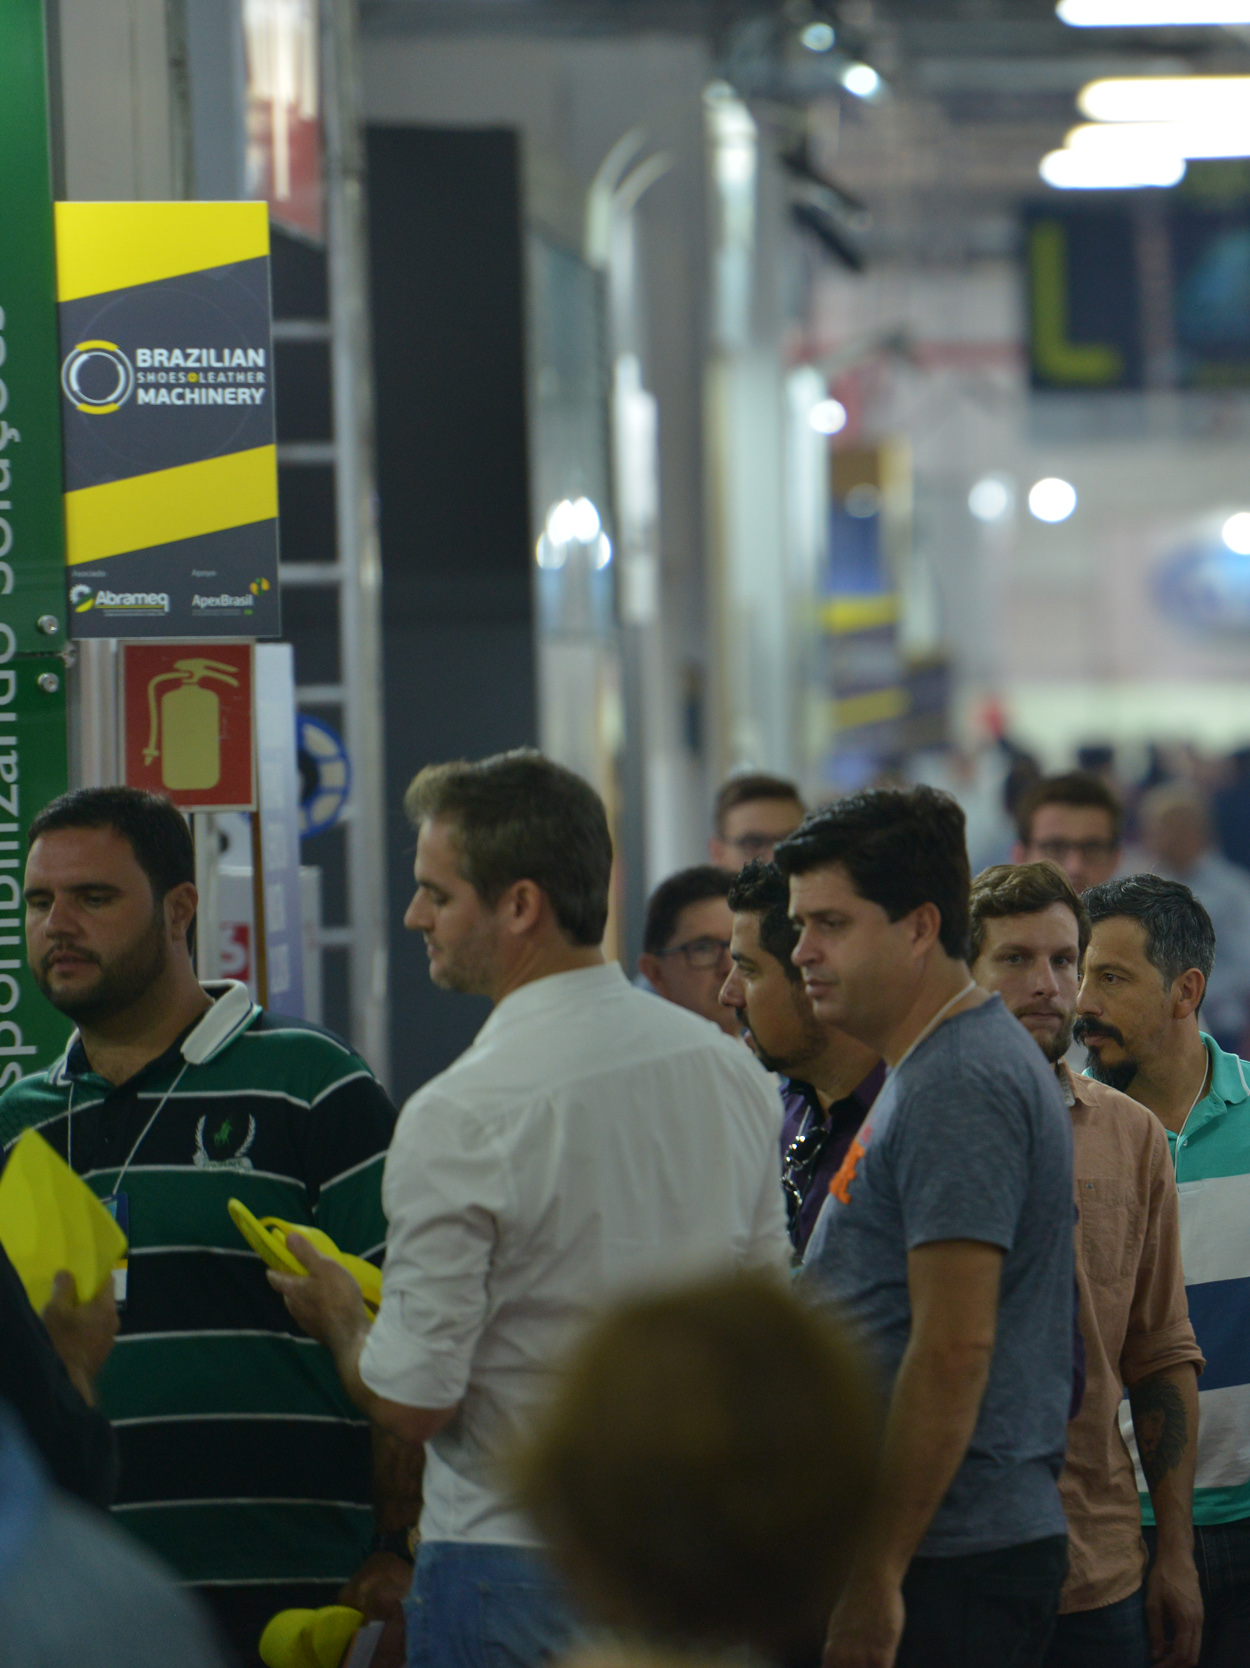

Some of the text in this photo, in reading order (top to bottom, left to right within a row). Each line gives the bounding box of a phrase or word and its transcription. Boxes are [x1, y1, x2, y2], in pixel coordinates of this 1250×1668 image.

[1033, 220, 1123, 385] L
[135, 348, 266, 368] BRAZILIAN
[136, 371, 266, 384] SHOES LEATHER
[136, 387, 266, 406] MACHINERY
[95, 590, 254, 613] Abrameq ApexBrasil
